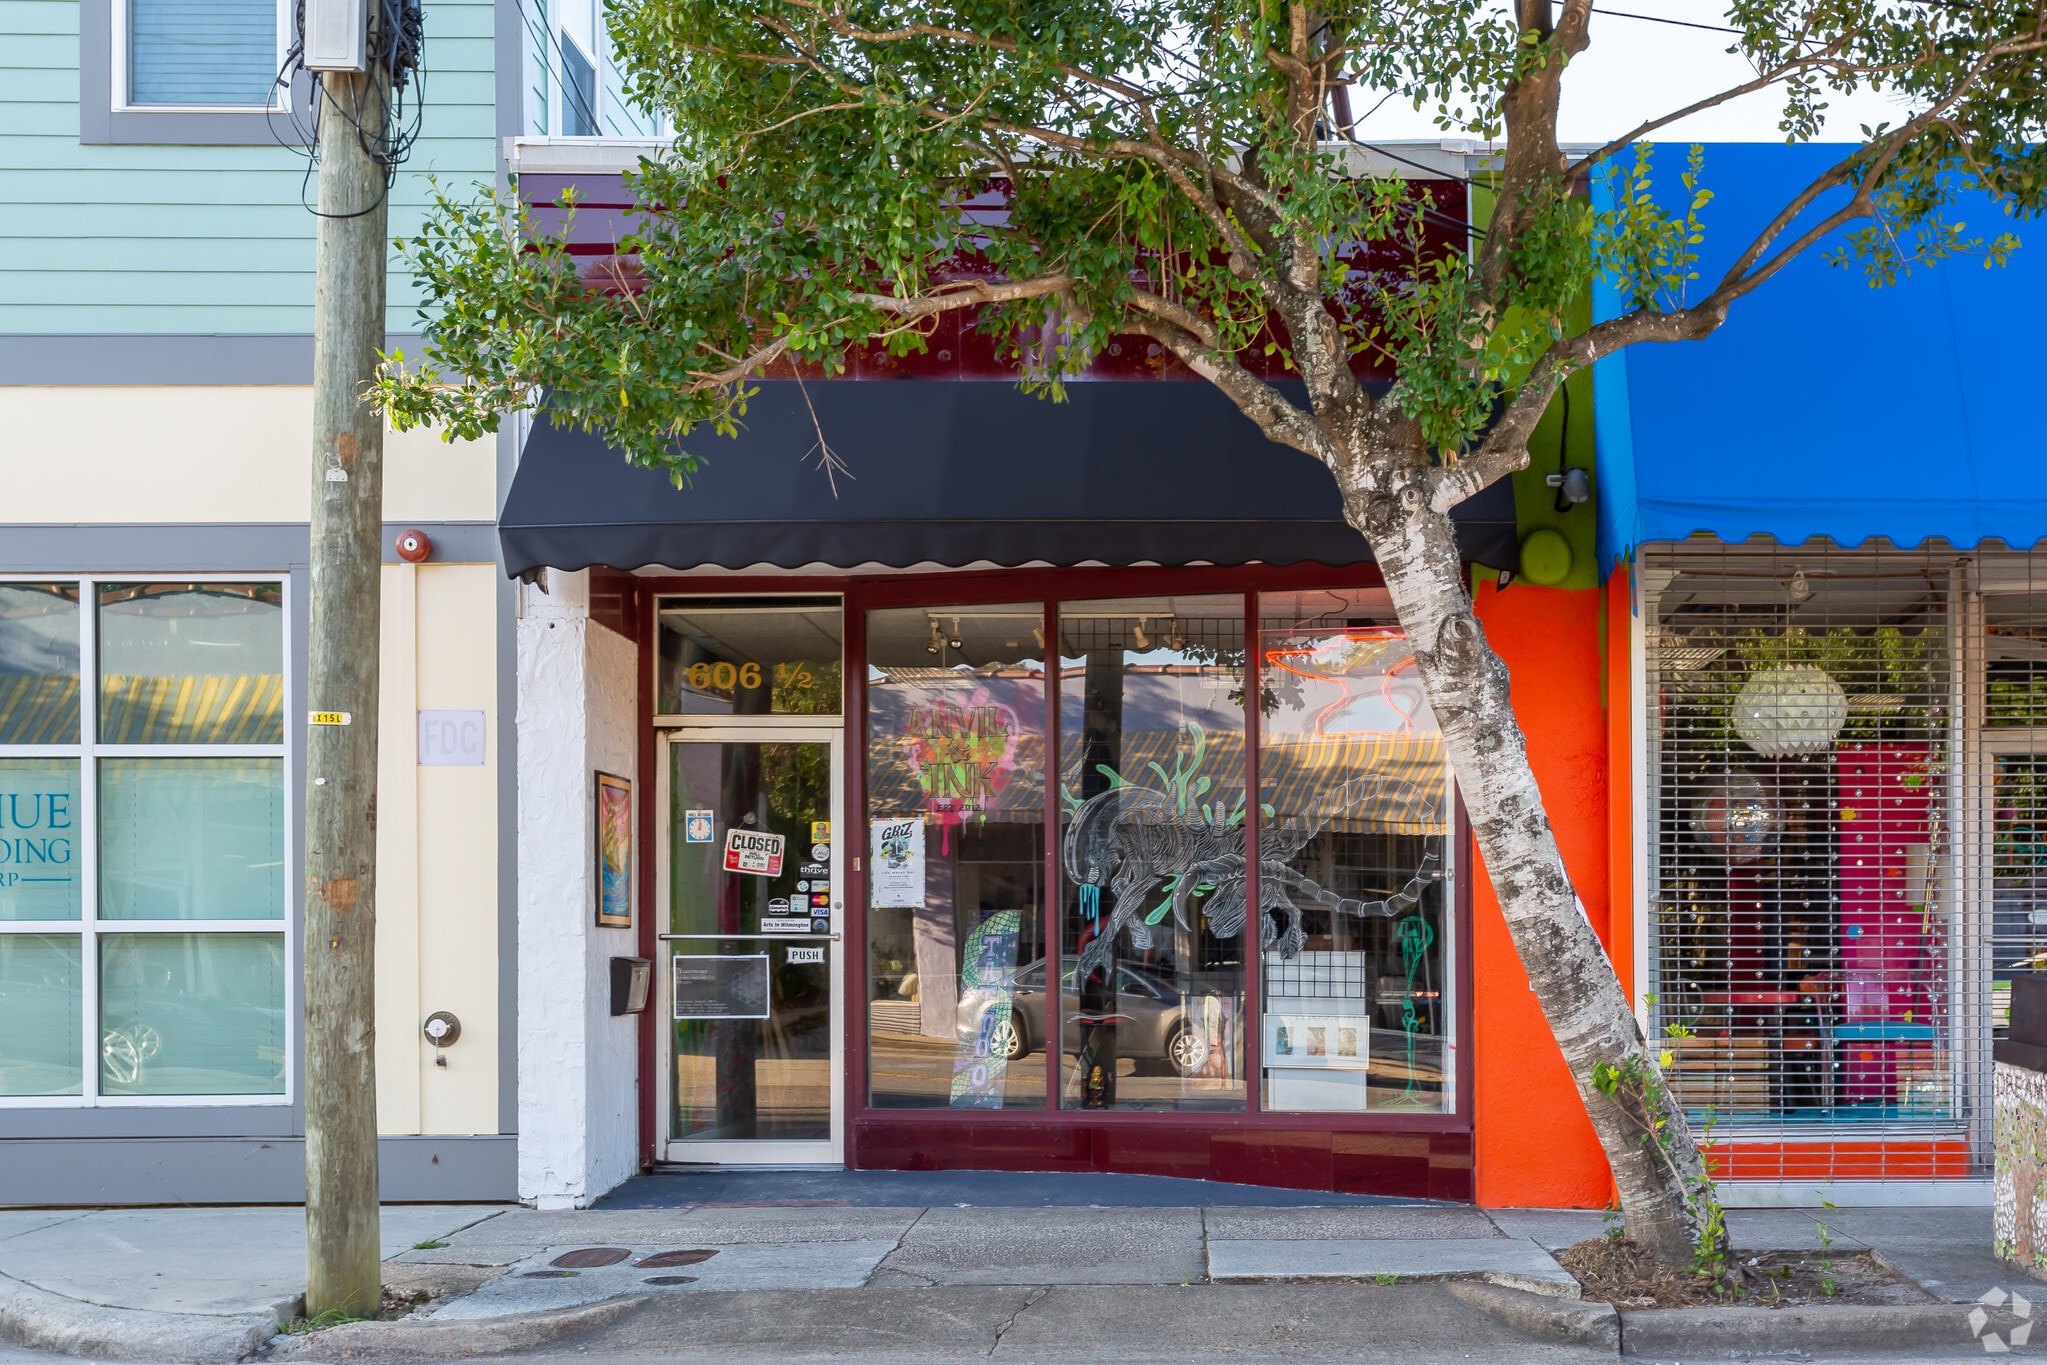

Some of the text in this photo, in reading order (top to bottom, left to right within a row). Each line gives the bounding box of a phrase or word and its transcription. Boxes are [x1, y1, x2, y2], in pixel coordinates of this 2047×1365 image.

[688, 662, 762, 690] 606
[424, 719, 478, 755] FDC
[906, 706, 1015, 742] ANVIL
[924, 761, 999, 799] INK
[0, 793, 72, 829] UE
[731, 834, 780, 855] CLOSED
[800, 865, 829, 875] thrive
[792, 951, 819, 960] PUSH
[970, 934, 1003, 1088] TATTOO
